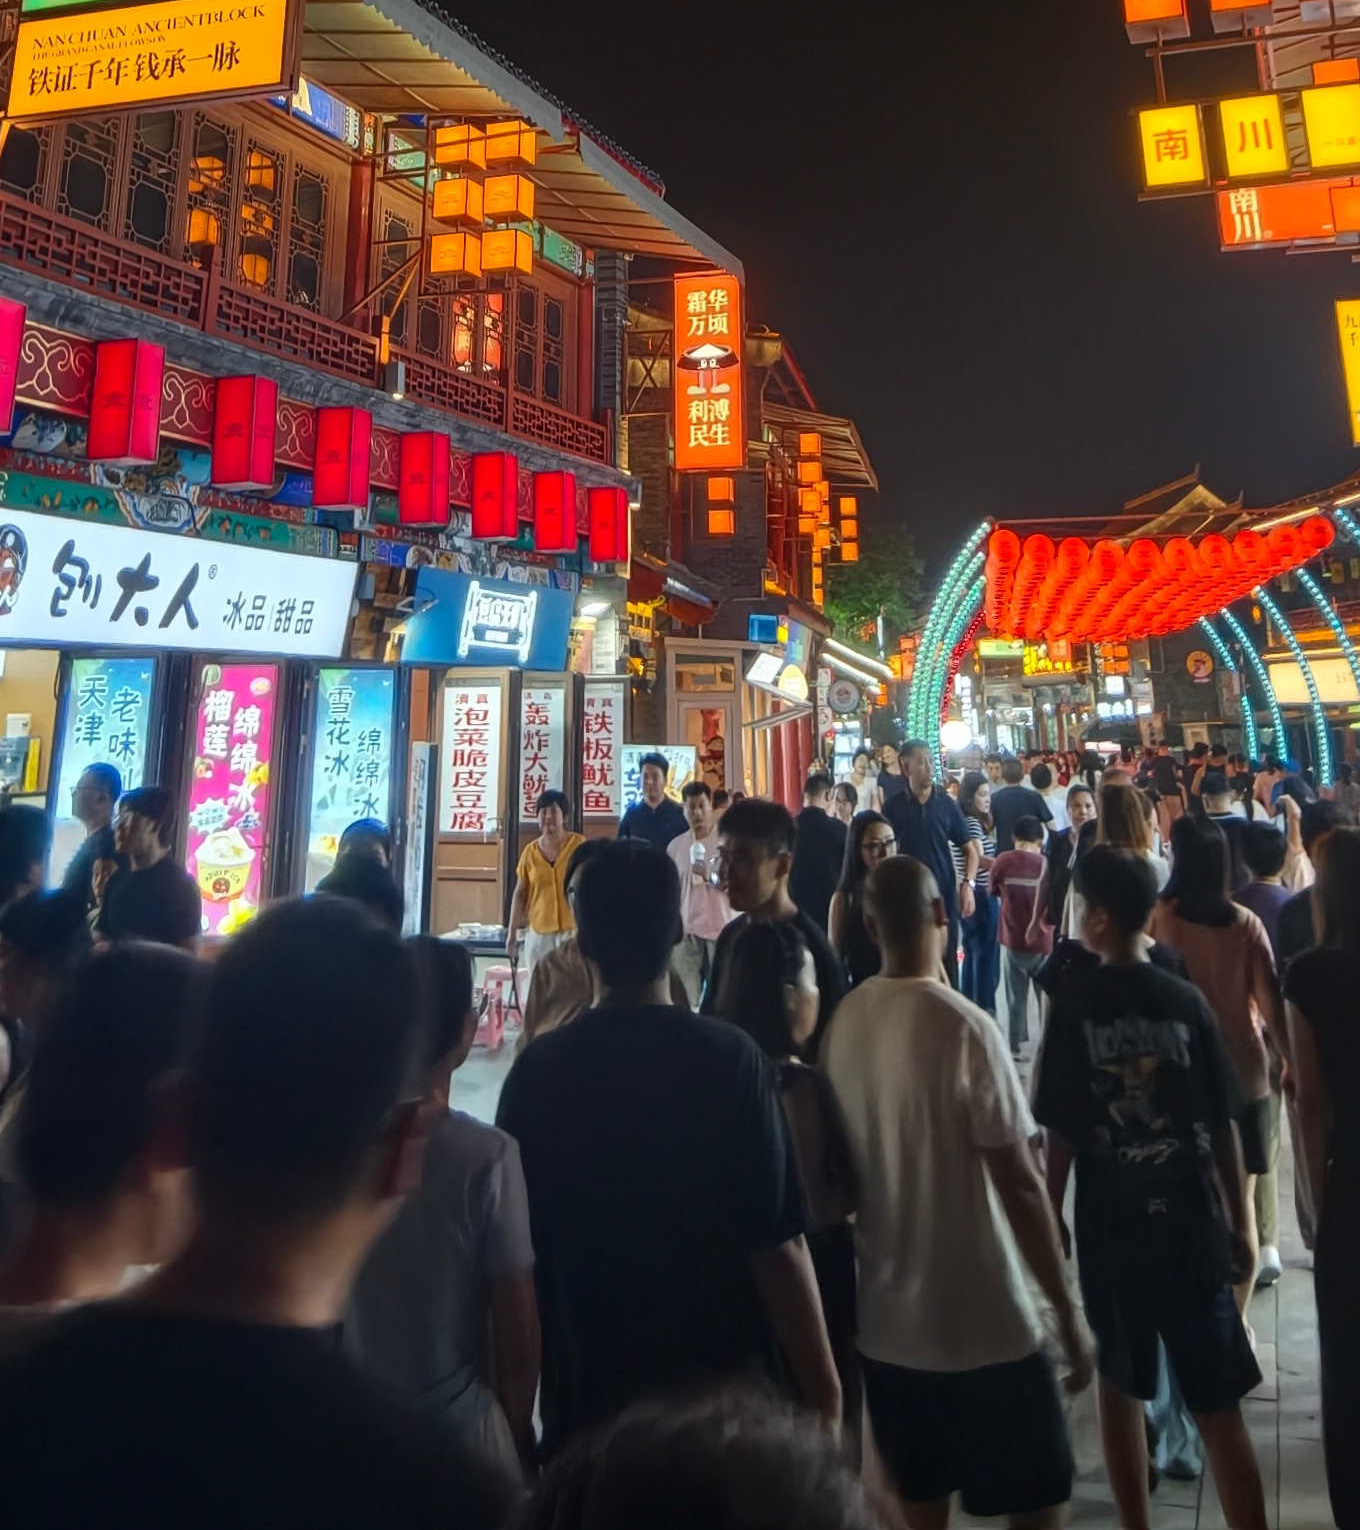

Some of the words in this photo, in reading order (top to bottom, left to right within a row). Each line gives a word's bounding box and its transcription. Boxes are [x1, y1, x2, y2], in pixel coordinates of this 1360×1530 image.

[1153, 128, 1189, 162] 南
[1239, 118, 1272, 152] 川
[1229, 188, 1261, 243] 南川
[687, 289, 728, 313] 霜华
[687, 313, 728, 336] 万顷
[689, 424, 730, 447] 民生
[74, 674, 108, 747] 天津
[109, 686, 141, 790] 老味
[203, 689, 234, 758] 榴莲
[324, 685, 355, 777] 雪花冰
[353, 728, 382, 817] 绵绵冰
[450, 707, 489, 831] 泡菜脆皮豆腐
[583, 710, 614, 812] 铁板鱿鱼
